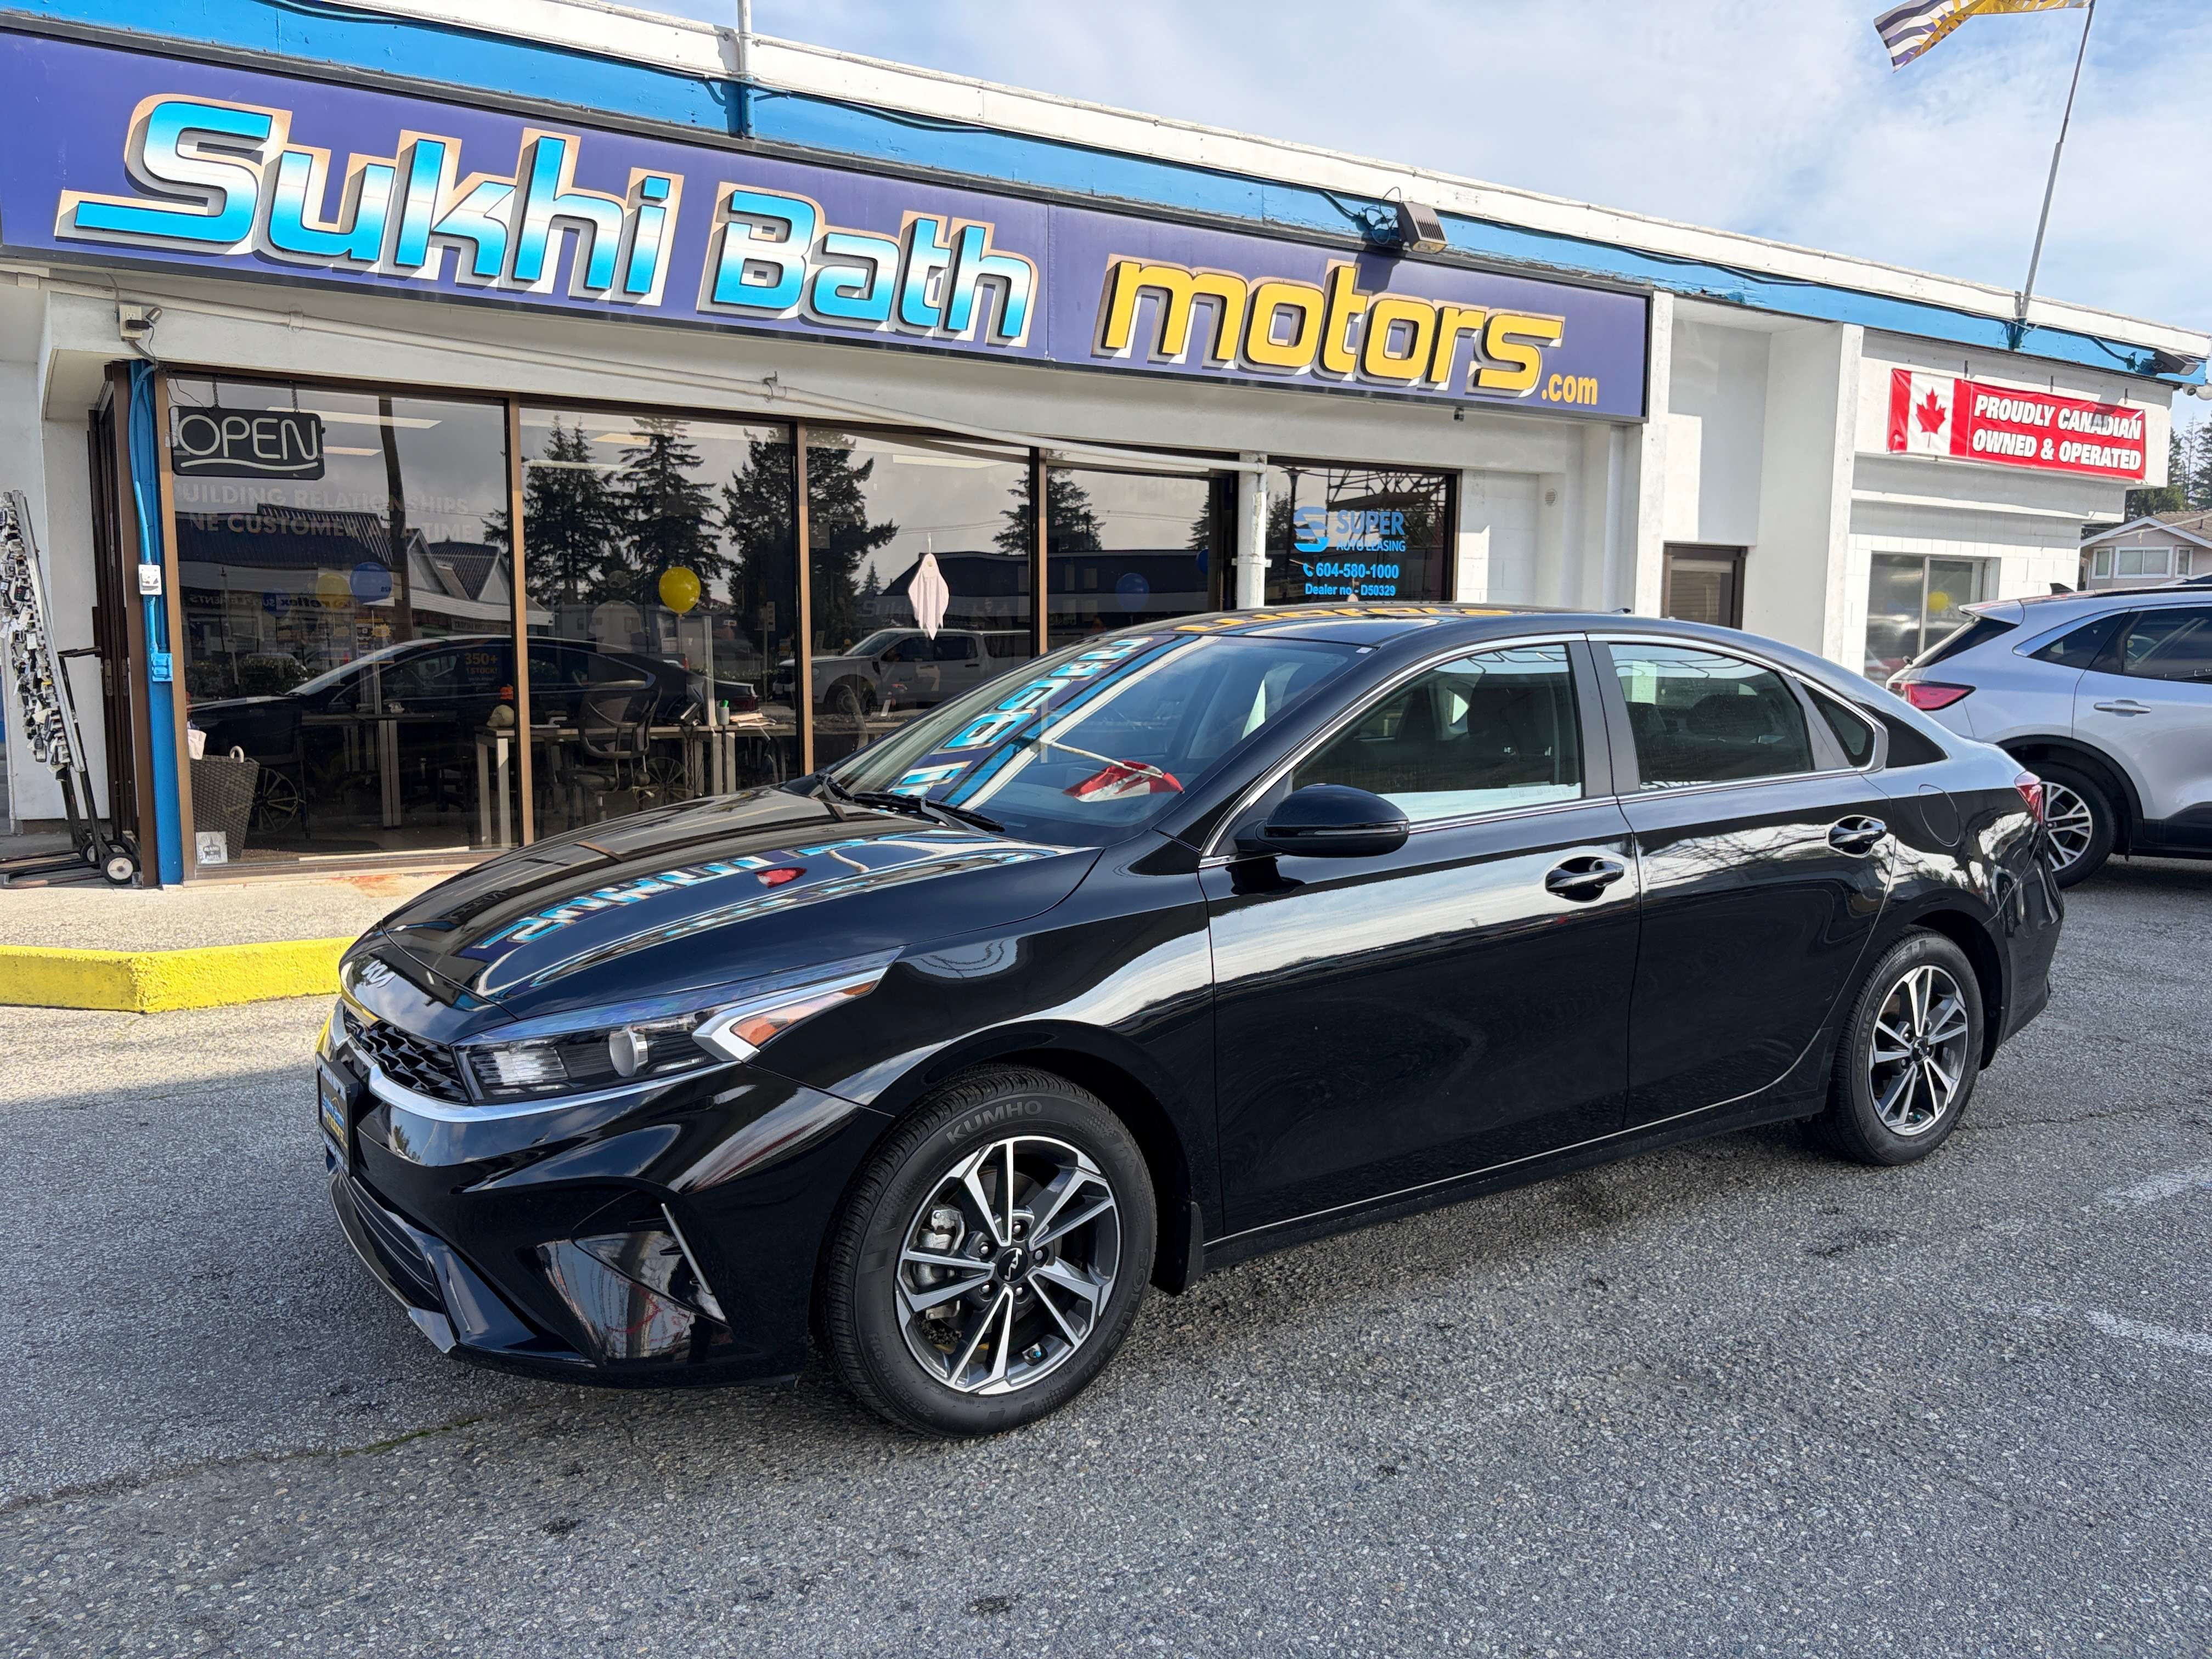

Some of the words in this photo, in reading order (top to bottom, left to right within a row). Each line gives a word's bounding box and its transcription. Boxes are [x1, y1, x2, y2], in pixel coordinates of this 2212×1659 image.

[55, 93, 685, 306] Sukhi
[695, 180, 1039, 347] Bath
[1093, 253, 1566, 397] motors
[1973, 395, 2055, 427] PROUDLY
[2057, 407, 2142, 440] CANADIAN
[178, 414, 319, 461] OPEN
[1972, 429, 2038, 458] OWNED
[2040, 438, 2055, 461] &
[2058, 443, 2142, 471] OPERATED
[228, 514, 362, 540] CUSTOMER
[418, 523, 473, 540] TIME
[1336, 510, 1406, 536] SUPER
[1365, 540, 1406, 552] LEASING
[1316, 562, 1399, 579] 604-580-1000
[1305, 583, 1338, 595] Dealer
[1340, 586, 1352, 595] no
[1361, 584, 1396, 596] D50329
[945, 1099, 1043, 1147] KUMHO
[1107, 1248, 1149, 1351] SOLUS
[880, 1361, 900, 1387] R16
[894, 1385, 935, 1417] 205/55
